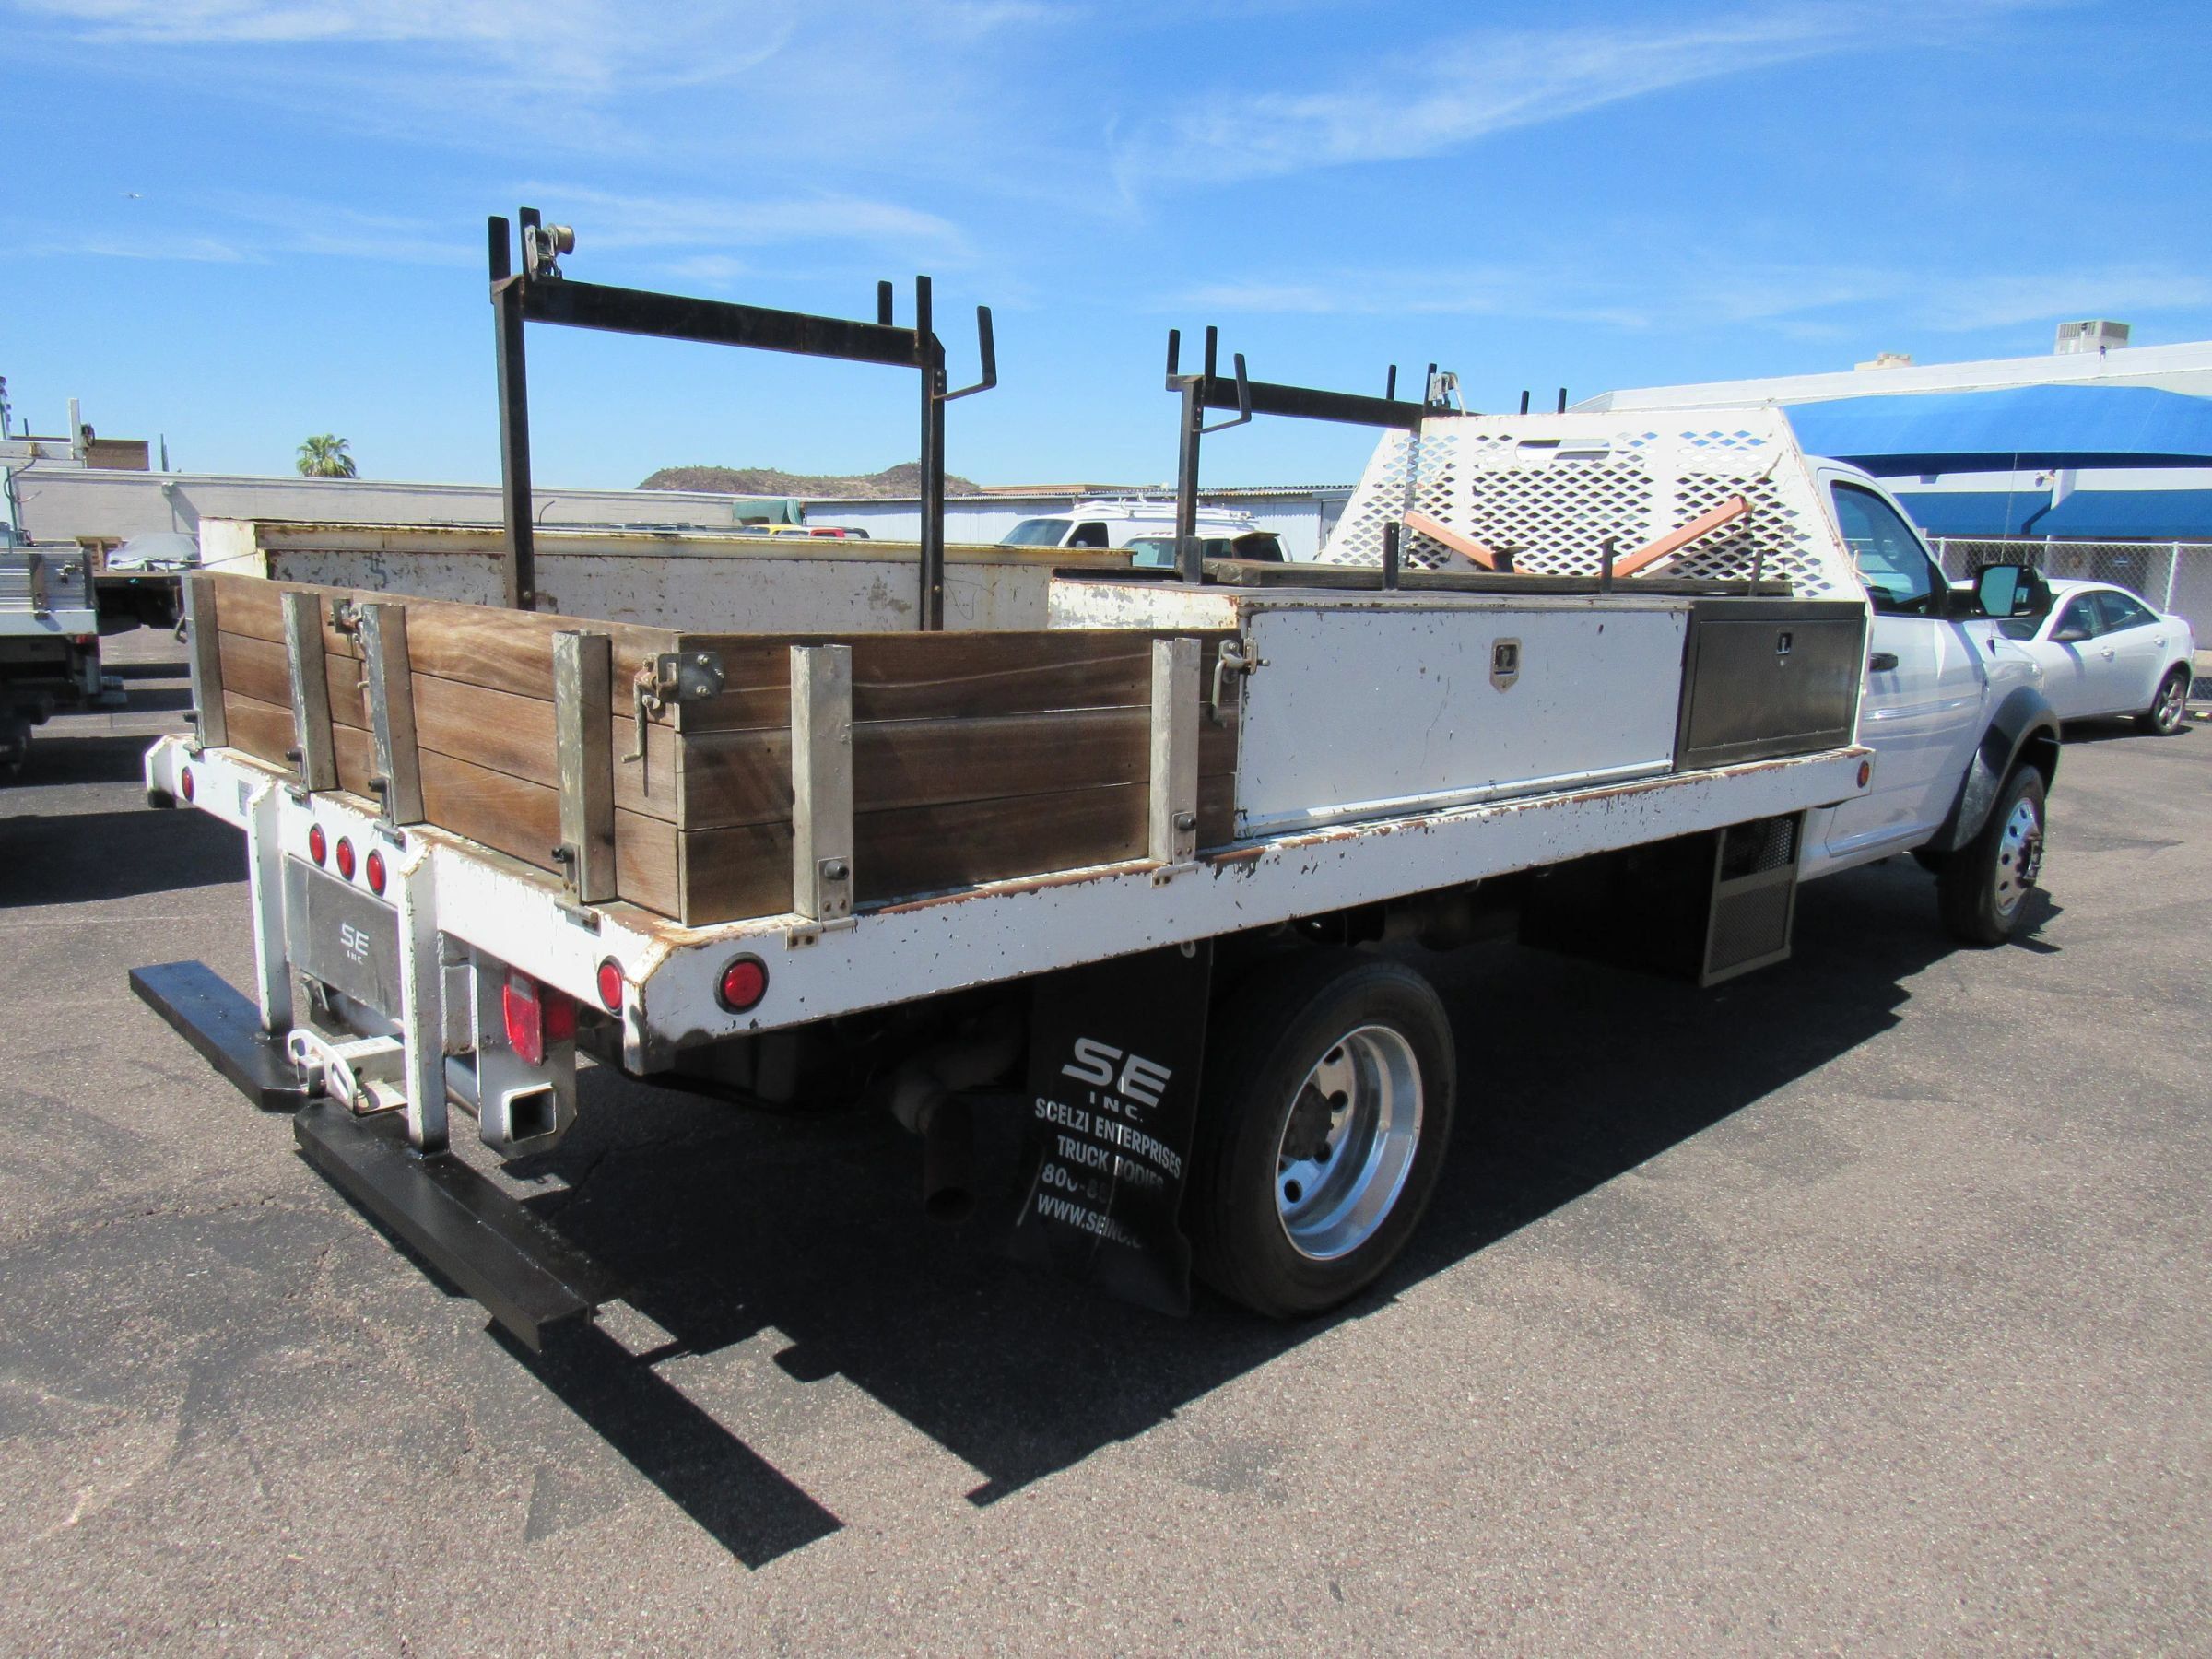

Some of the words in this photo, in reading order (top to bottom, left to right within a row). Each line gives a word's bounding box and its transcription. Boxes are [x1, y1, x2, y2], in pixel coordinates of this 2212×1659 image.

[340, 921, 370, 957] SE
[1061, 1036, 1172, 1108] SE
[1088, 1090, 1144, 1124] INC.
[1034, 1097, 1090, 1134] SCELZI
[1094, 1114, 1182, 1181] ENTERPRISES
[1056, 1135, 1111, 1173] TRUCK
[1112, 1154, 1165, 1190] BODIES
